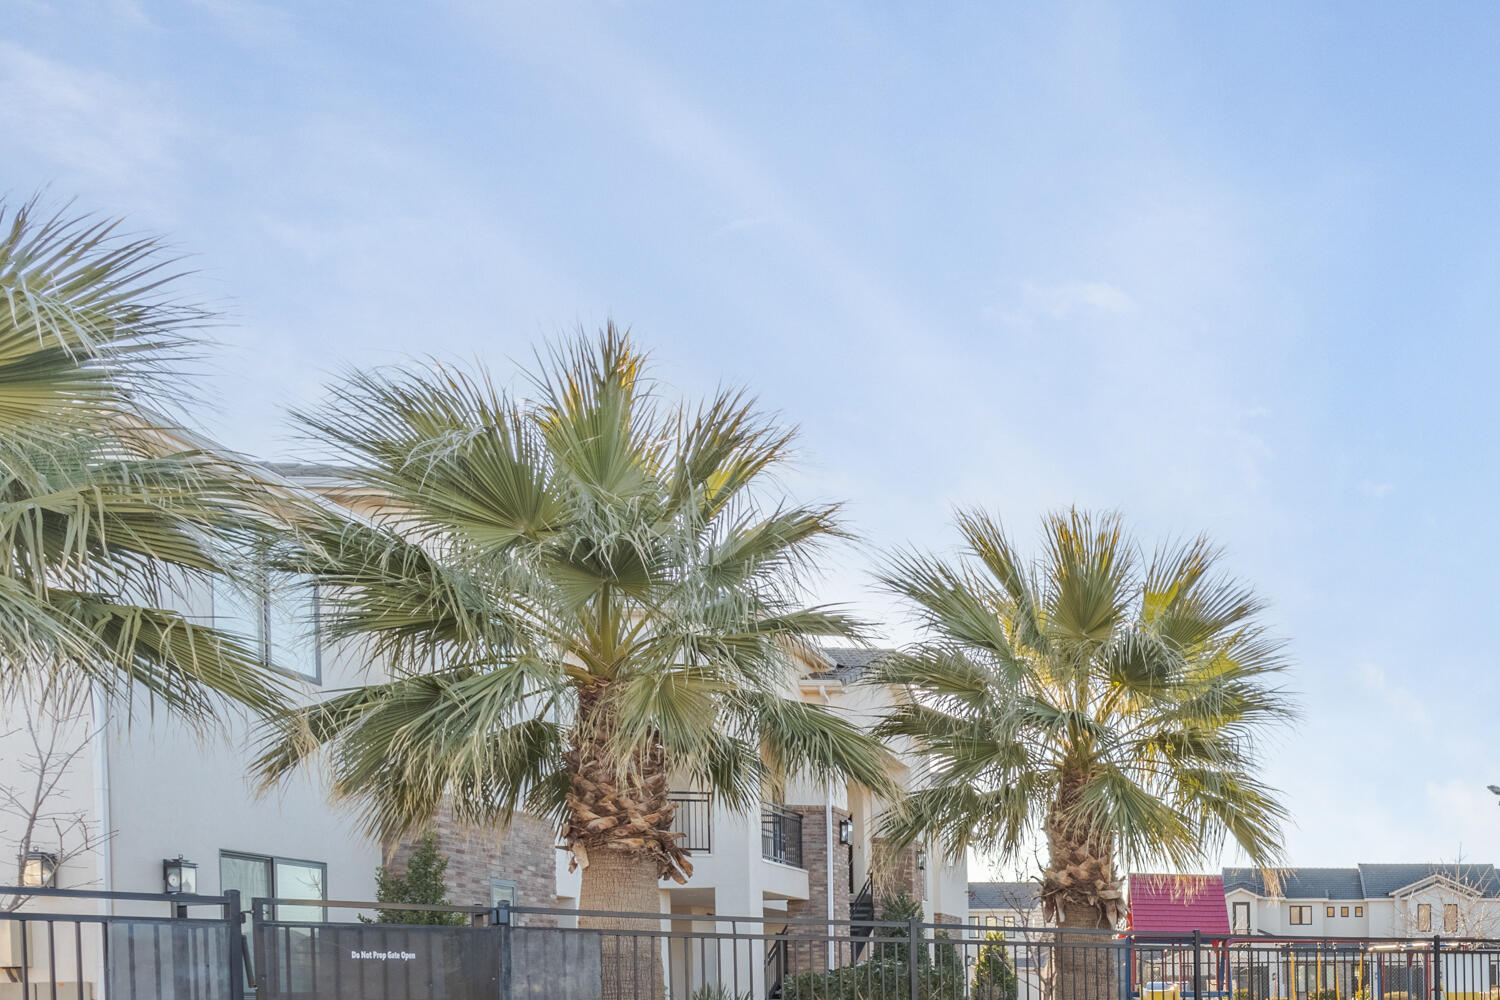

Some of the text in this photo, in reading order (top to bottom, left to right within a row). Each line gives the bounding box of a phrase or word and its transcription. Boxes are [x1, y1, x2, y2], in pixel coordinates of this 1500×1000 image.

[351, 951, 416, 961] Do Not Prop Gate Open
